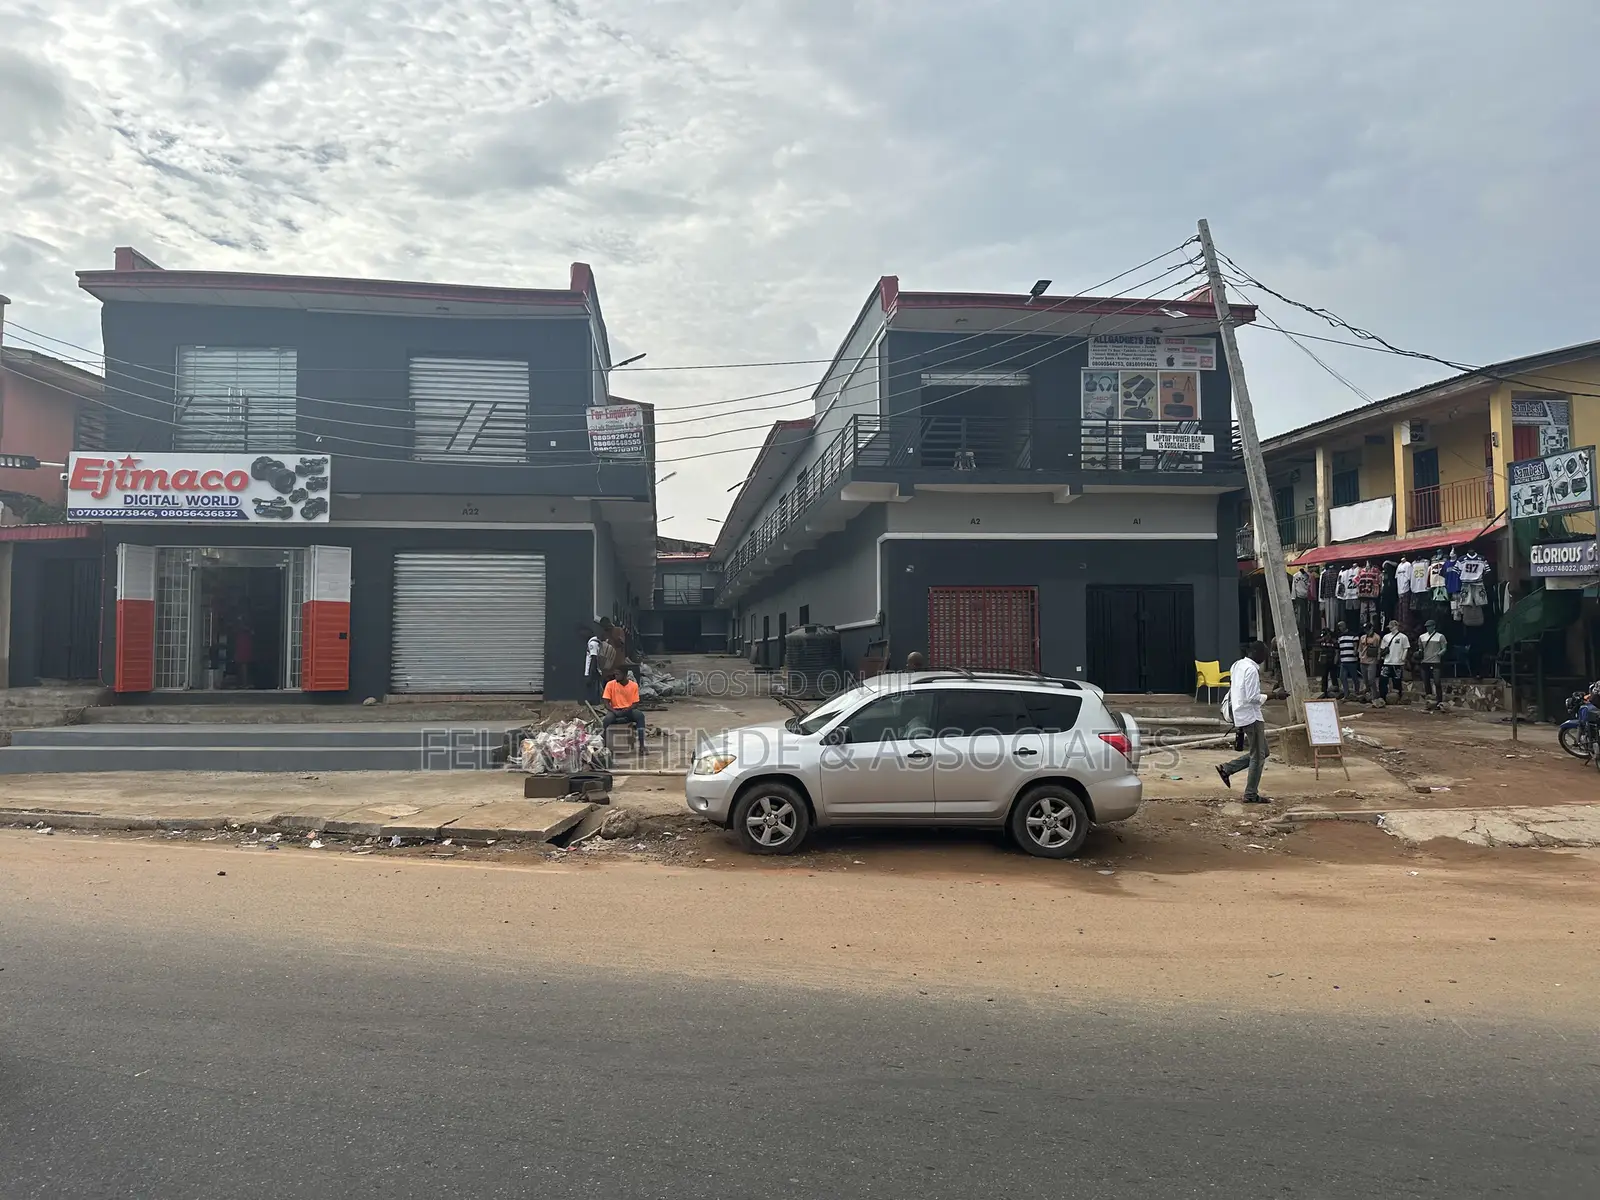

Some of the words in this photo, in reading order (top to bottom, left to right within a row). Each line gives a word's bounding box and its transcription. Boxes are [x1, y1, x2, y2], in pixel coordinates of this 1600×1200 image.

[590, 409, 603, 420] For
[1514, 461, 1545, 479] Sambest
[69, 455, 249, 500] Ejimaco
[124, 494, 179, 506] DIGITAL
[185, 495, 240, 506] WORLD
[76, 509, 158, 518] 07030273846,
[160, 510, 238, 518] 08056436832
[1531, 546, 1582, 564] GLORIOUS
[1465, 563, 1480, 574] 97
